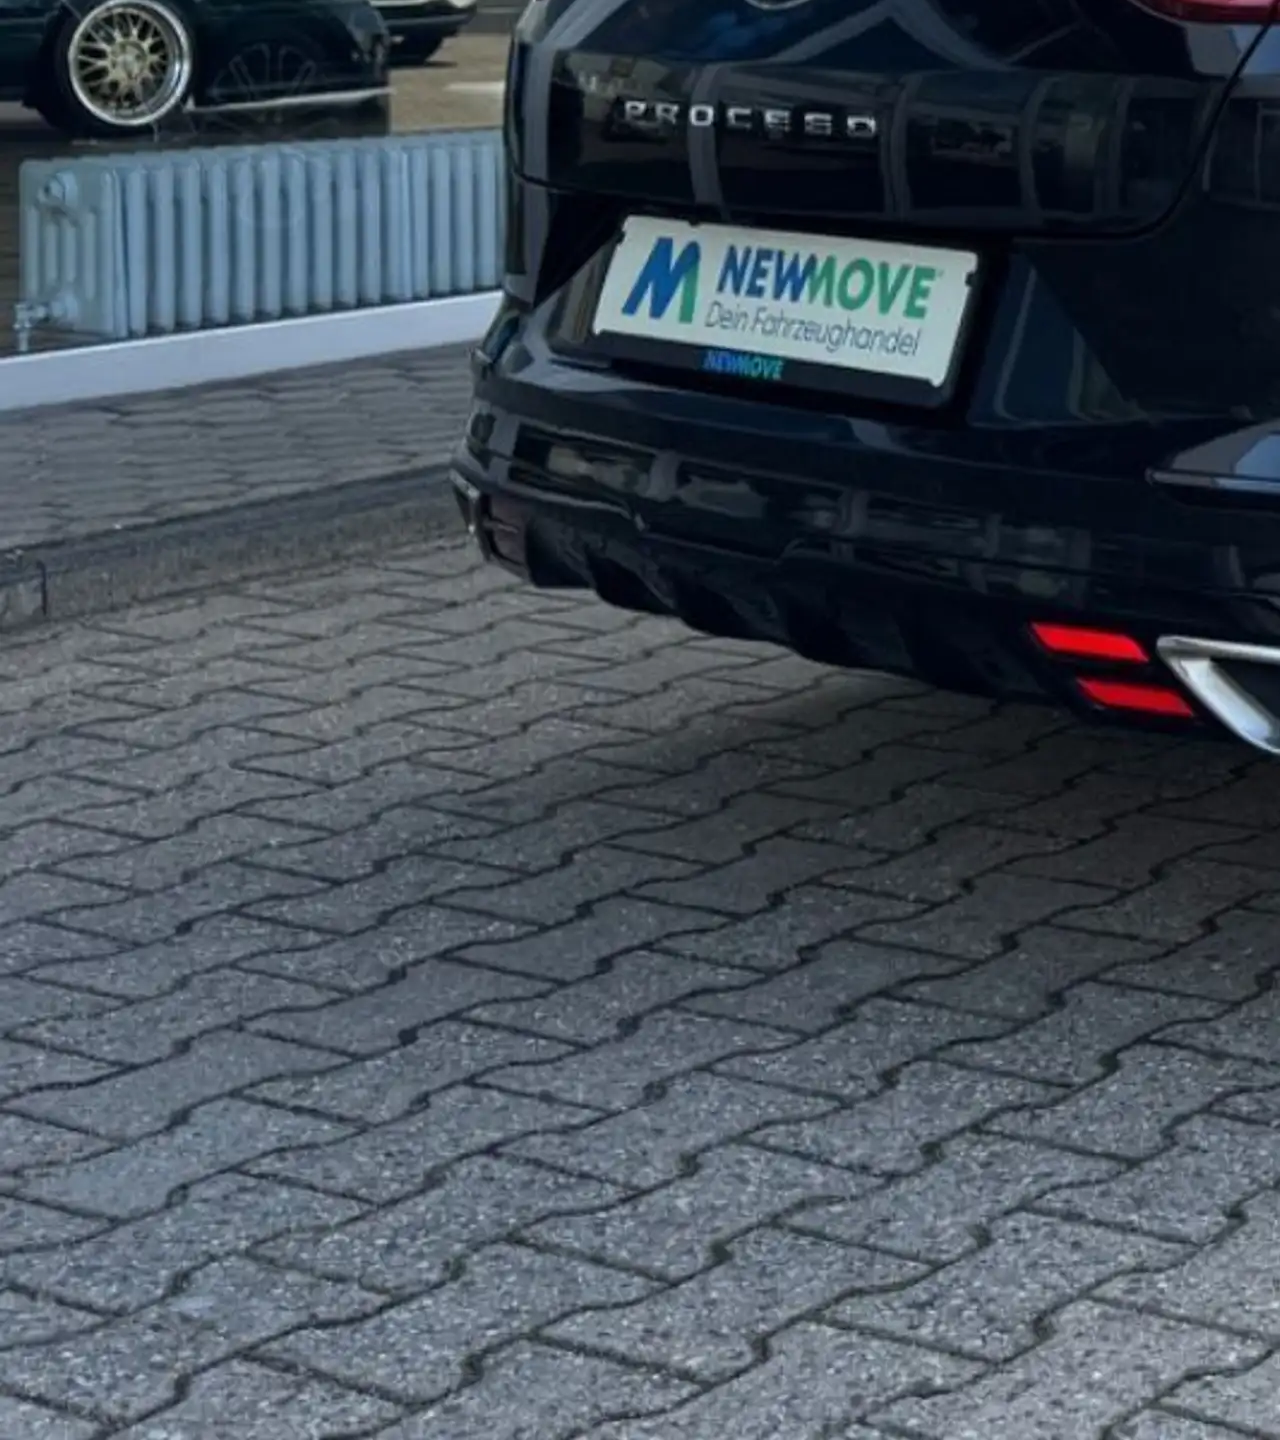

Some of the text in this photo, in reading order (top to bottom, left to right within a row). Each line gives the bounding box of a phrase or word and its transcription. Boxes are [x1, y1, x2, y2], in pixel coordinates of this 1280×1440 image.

[624, 101, 877, 137] PROCEED
[716, 244, 937, 320] NEWMOVE
[704, 301, 922, 357] Dein Fahrzeughandel
[704, 349, 785, 381] NEWMOVE
